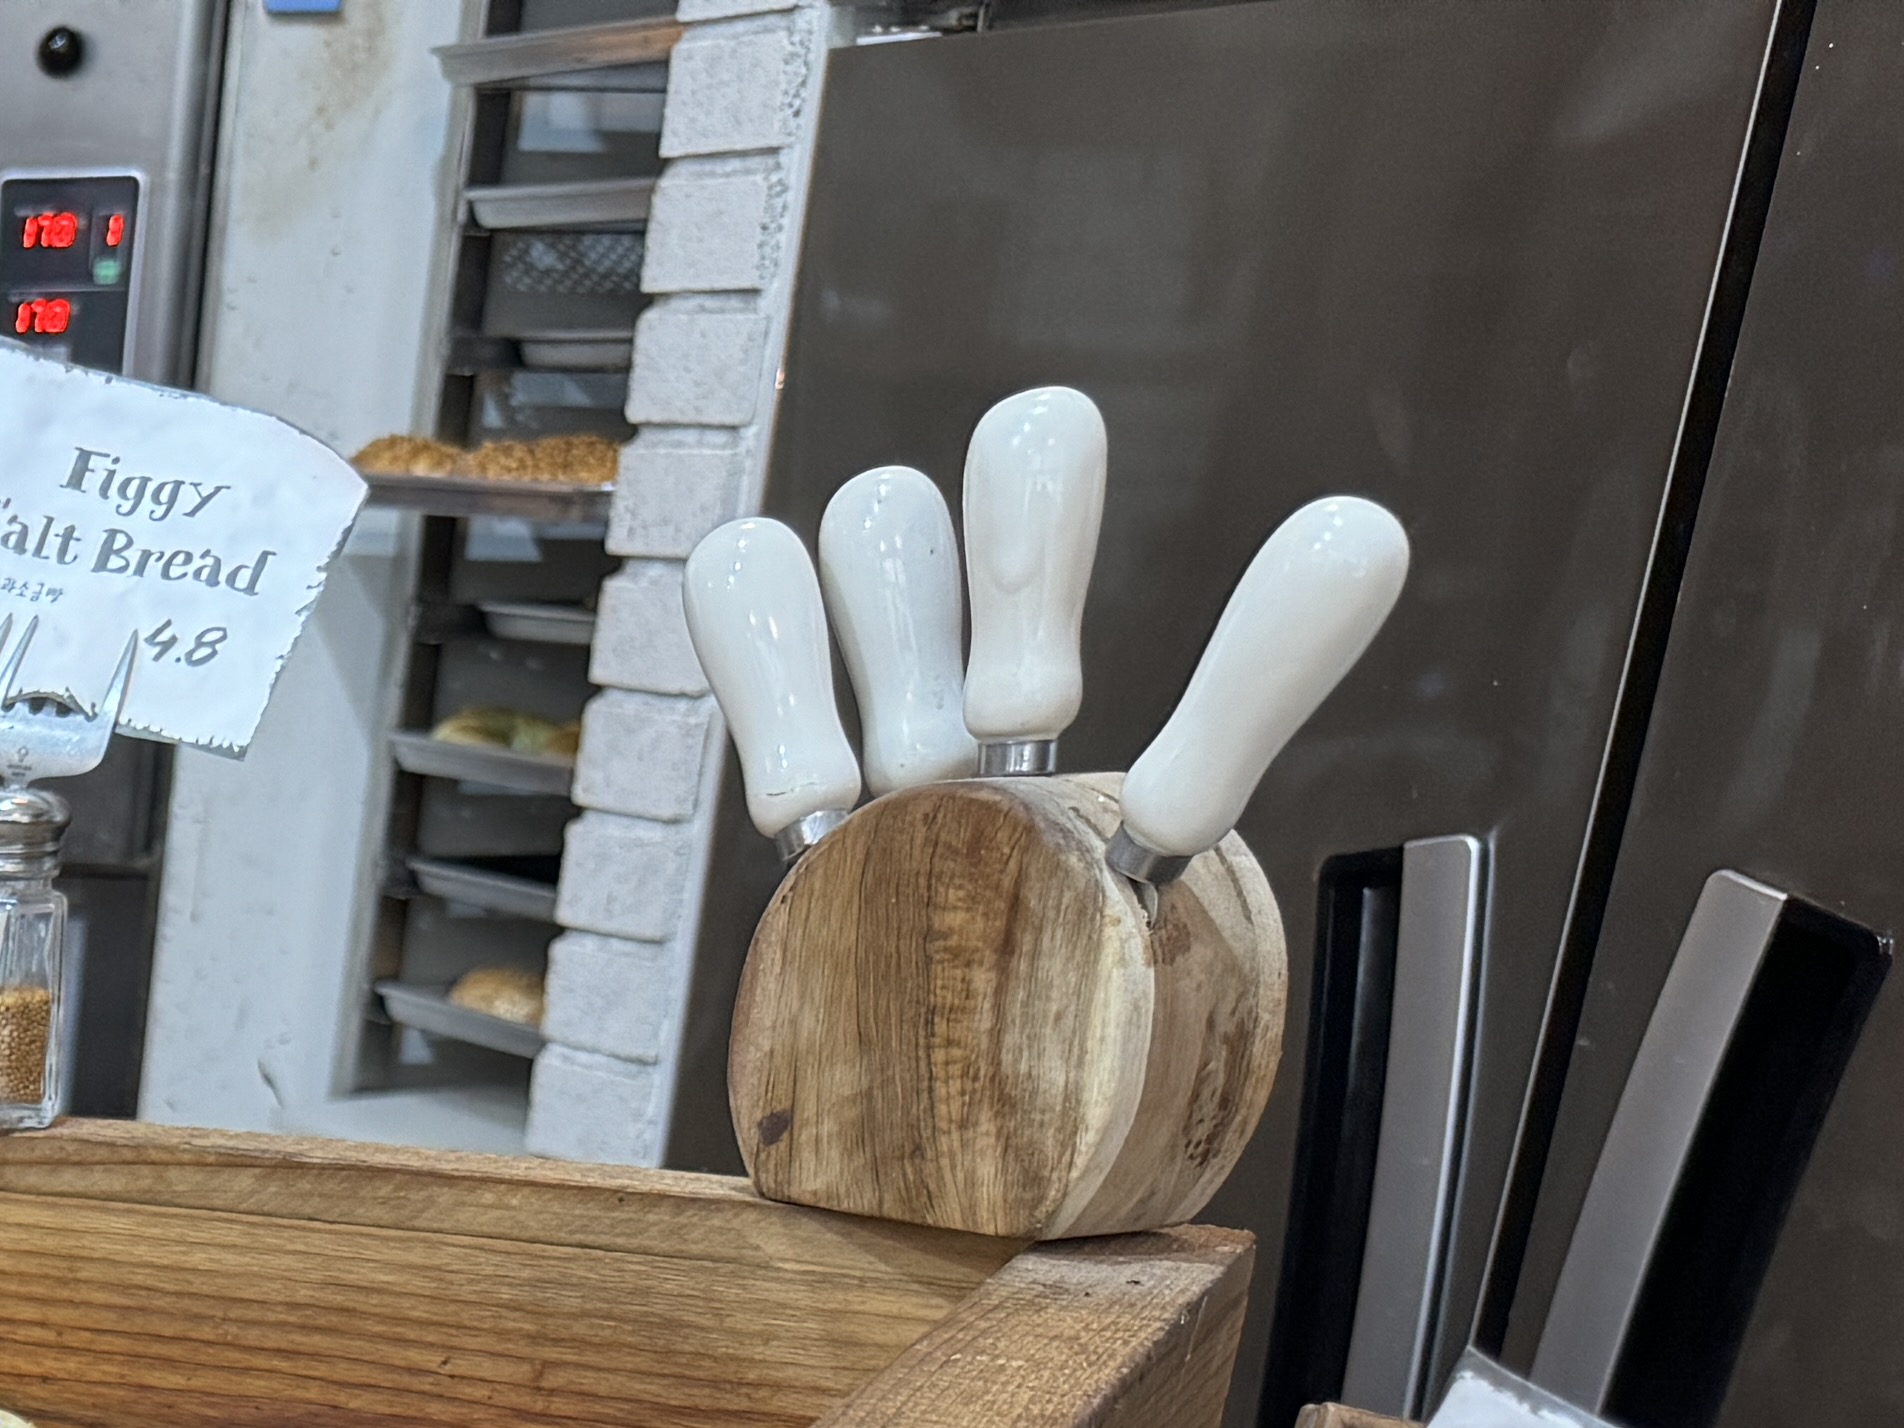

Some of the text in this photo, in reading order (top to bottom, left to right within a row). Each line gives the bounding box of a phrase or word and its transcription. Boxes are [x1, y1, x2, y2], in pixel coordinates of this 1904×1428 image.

[59, 447, 231, 522] Figgy
[91, 528, 277, 597] Bread
[144, 619, 228, 667] 4.8
